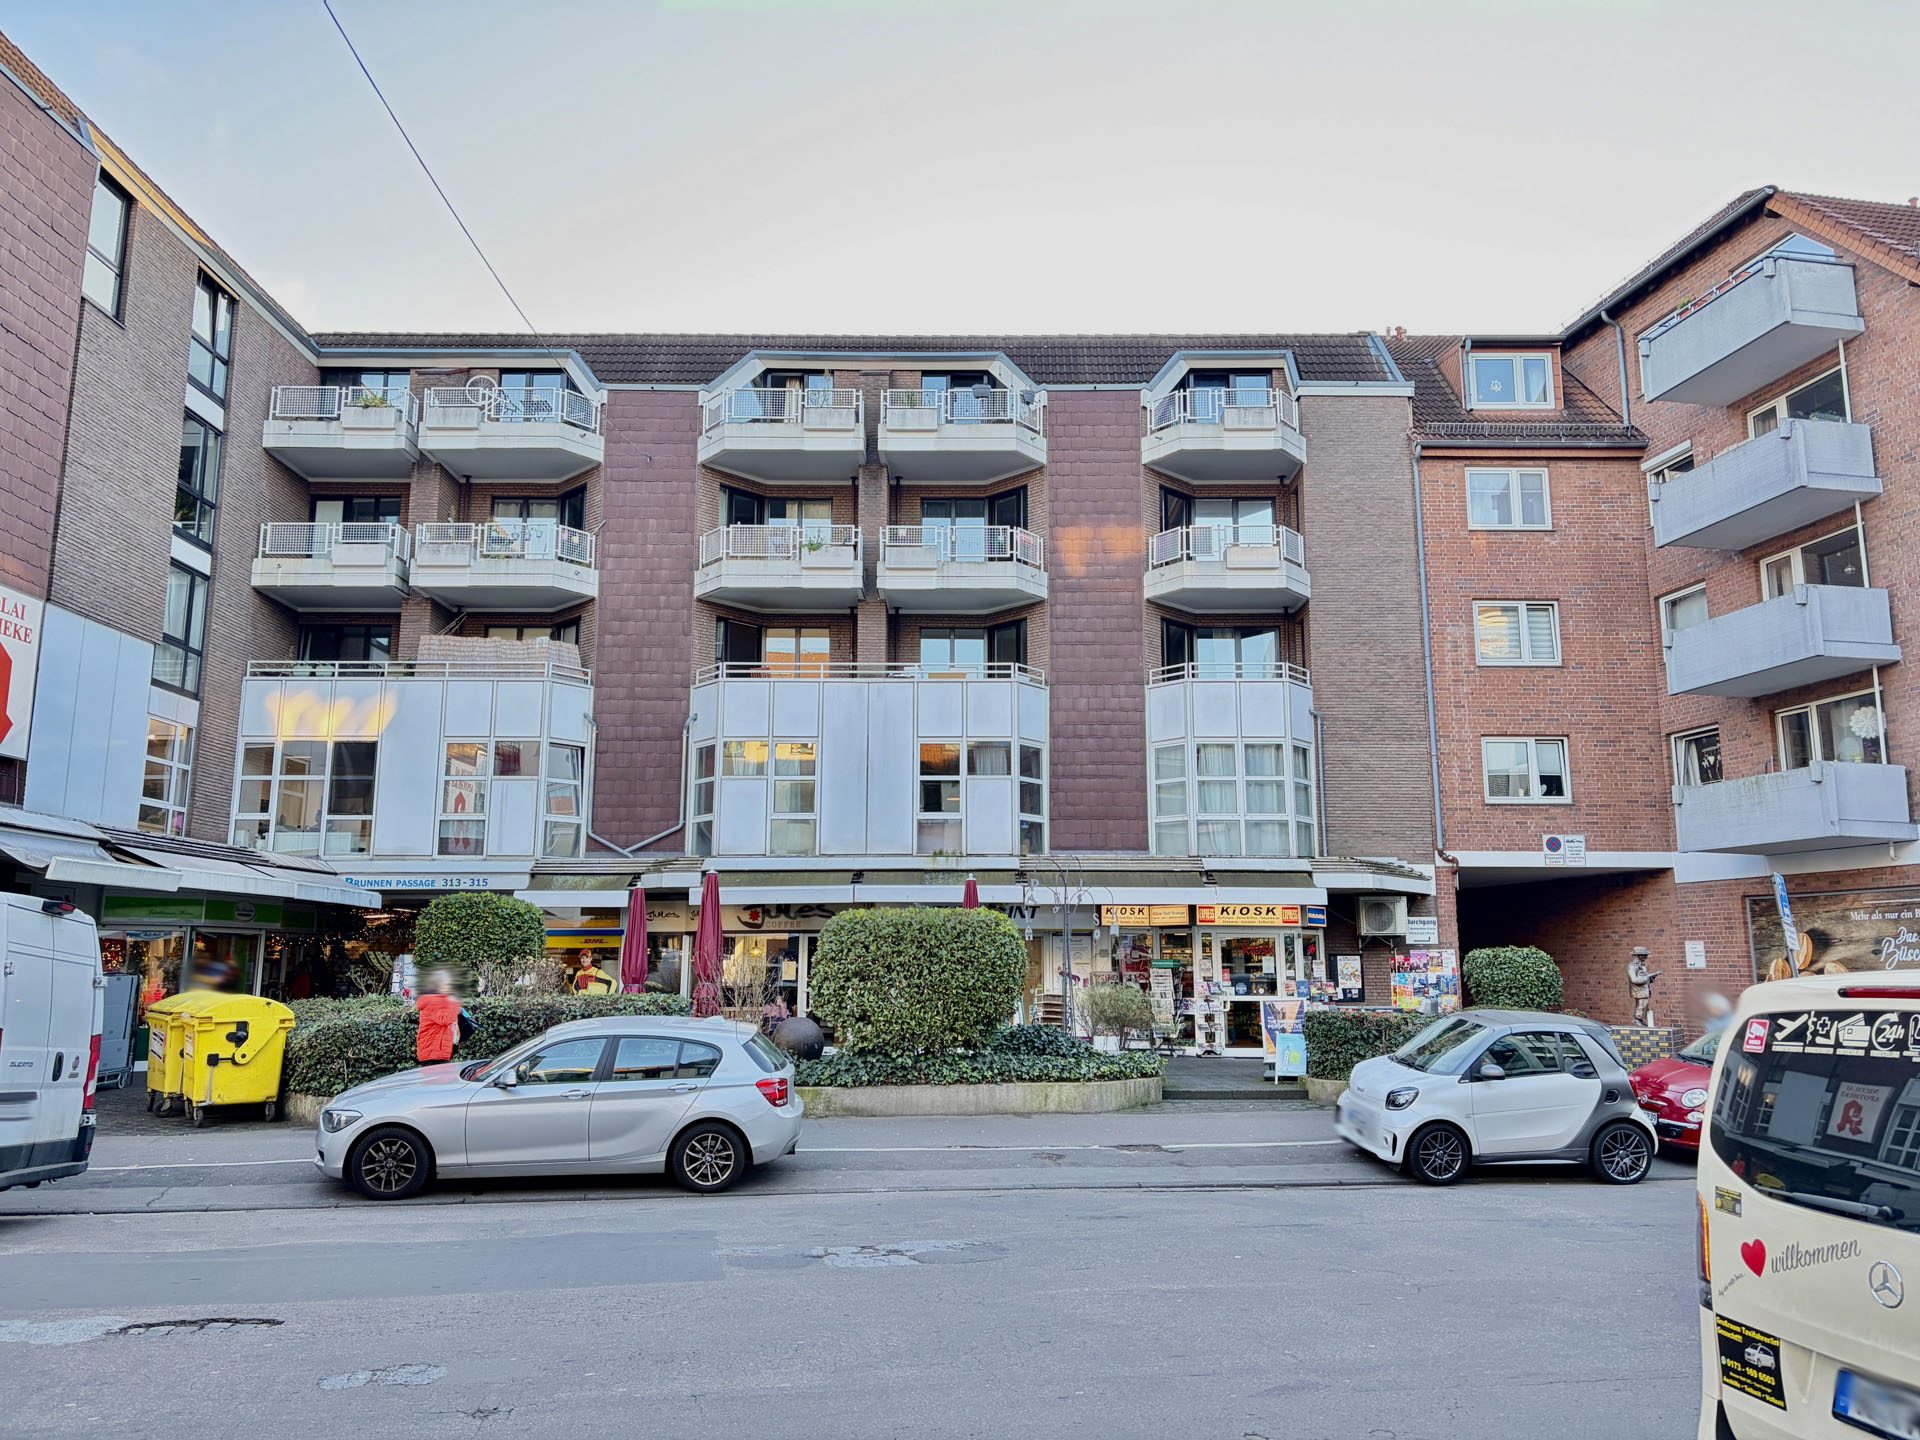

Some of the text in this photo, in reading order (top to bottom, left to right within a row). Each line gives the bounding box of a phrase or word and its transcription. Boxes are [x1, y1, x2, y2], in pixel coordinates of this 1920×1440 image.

[345, 877, 392, 888] BRUNNEN
[396, 879, 436, 888] PASSAGE
[441, 878, 461, 888] 313
[469, 878, 489, 888] 315
[1105, 907, 1146, 916] KOSK
[1850, 911, 1870, 921] Mehr
[1871, 910, 1883, 920] als
[1884, 911, 1899, 920] nur
[1900, 909, 1913, 919] ein
[765, 920, 803, 929] COFFEE
[1876, 1024, 1906, 1044] 24h
[1771, 1240, 1862, 1273] willkommen
